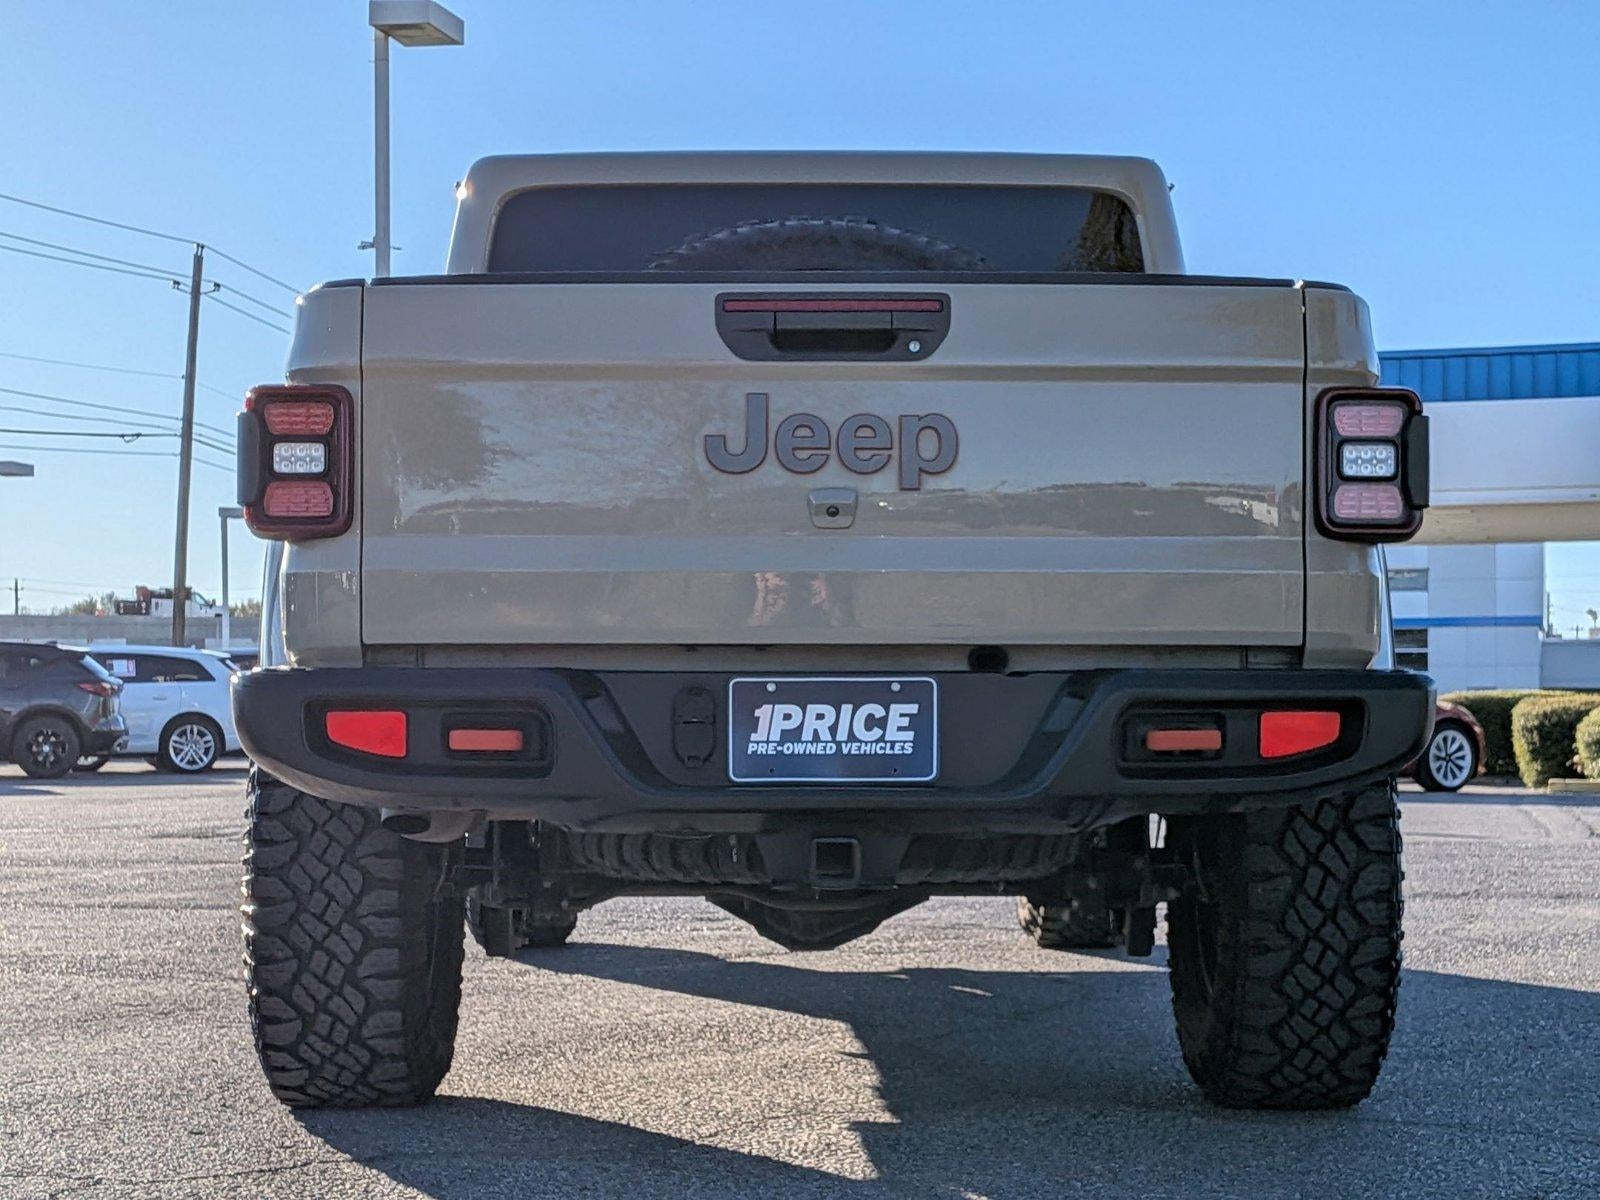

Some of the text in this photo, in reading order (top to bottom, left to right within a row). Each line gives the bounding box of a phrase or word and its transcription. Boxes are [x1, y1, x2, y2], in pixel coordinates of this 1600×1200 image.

[704, 392, 959, 491] Jeep
[748, 742, 914, 755] PRE-OWNED VEHICLES
